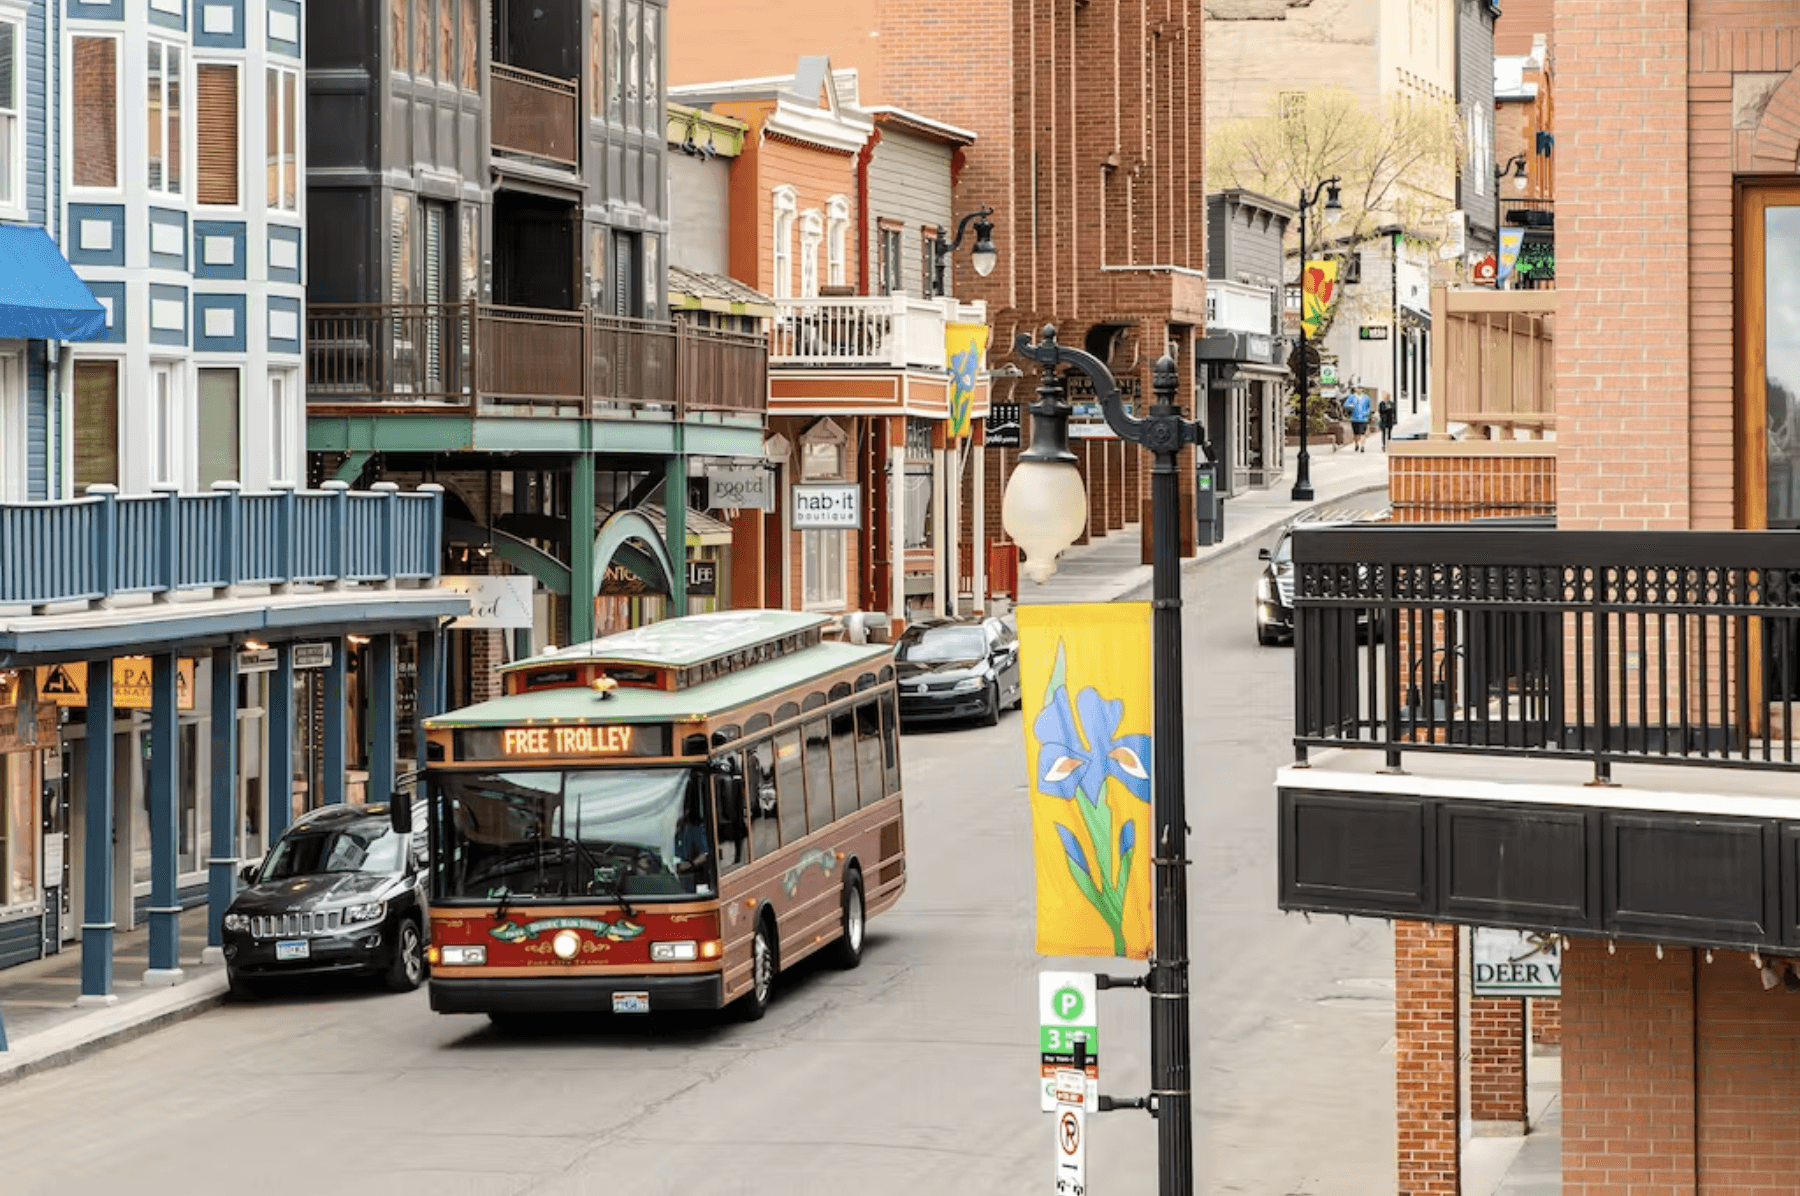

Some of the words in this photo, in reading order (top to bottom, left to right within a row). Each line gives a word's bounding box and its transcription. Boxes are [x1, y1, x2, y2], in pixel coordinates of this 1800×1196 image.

[798, 512, 853, 521] boutique
[504, 729, 549, 753] FREE
[553, 726, 631, 752] TROLLEY
[1476, 963, 1542, 983] DEER
[1062, 993, 1077, 1016] P
[1047, 1029, 1060, 1049] 3
